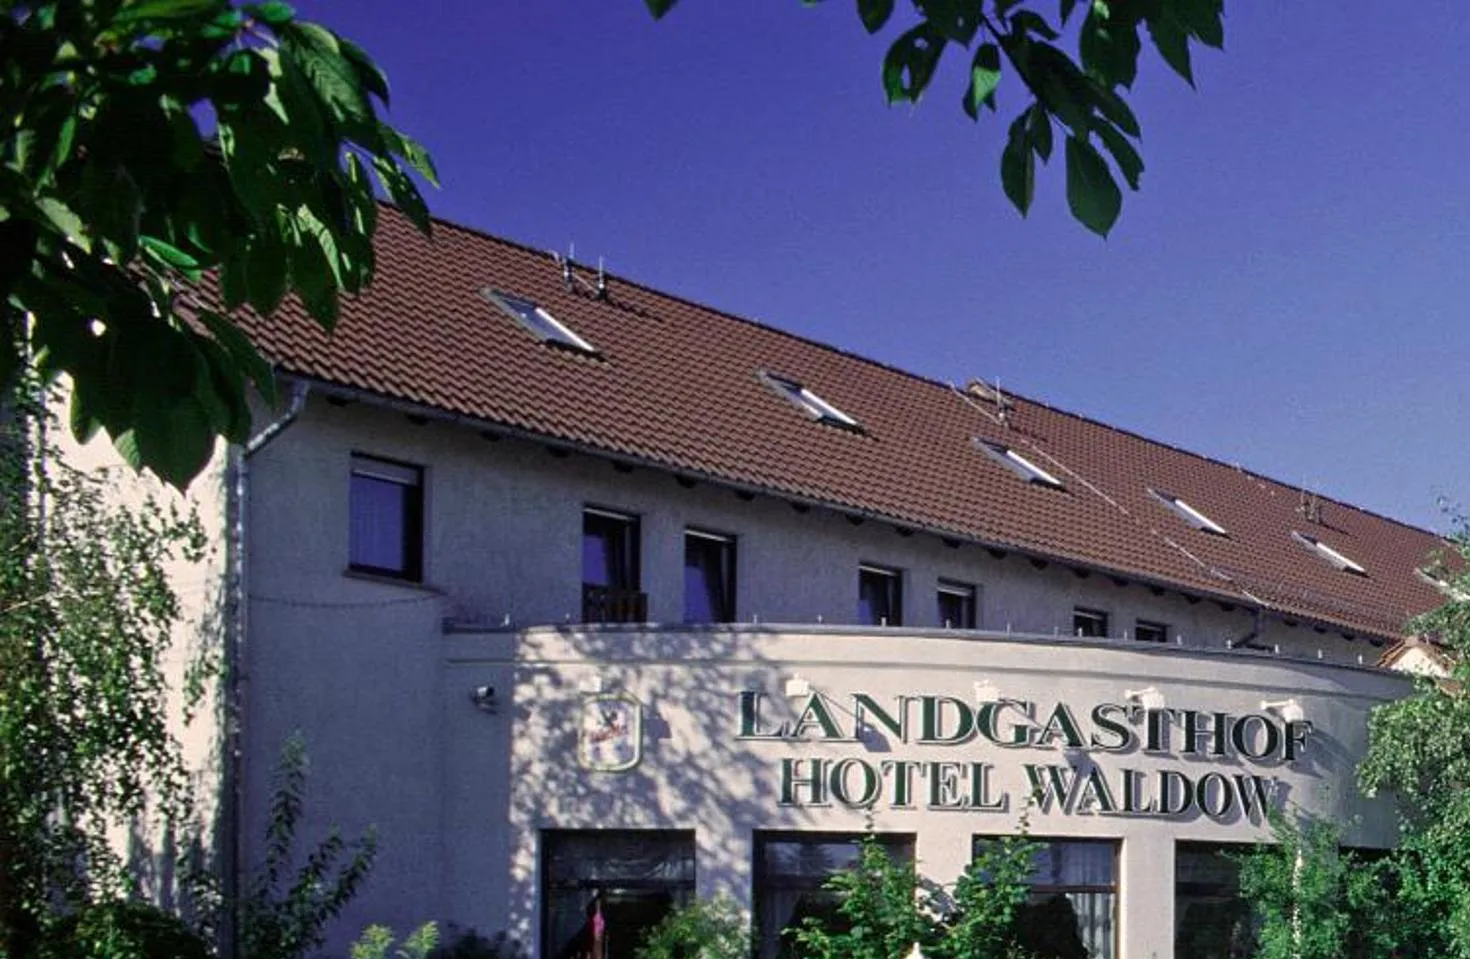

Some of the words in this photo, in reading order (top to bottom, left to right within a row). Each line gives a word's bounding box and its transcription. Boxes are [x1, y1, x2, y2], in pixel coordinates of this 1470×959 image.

[735, 689, 1314, 762] LANDGASTHOF
[777, 756, 1003, 811] HOTEL
[1024, 763, 1277, 819] WALDOW
